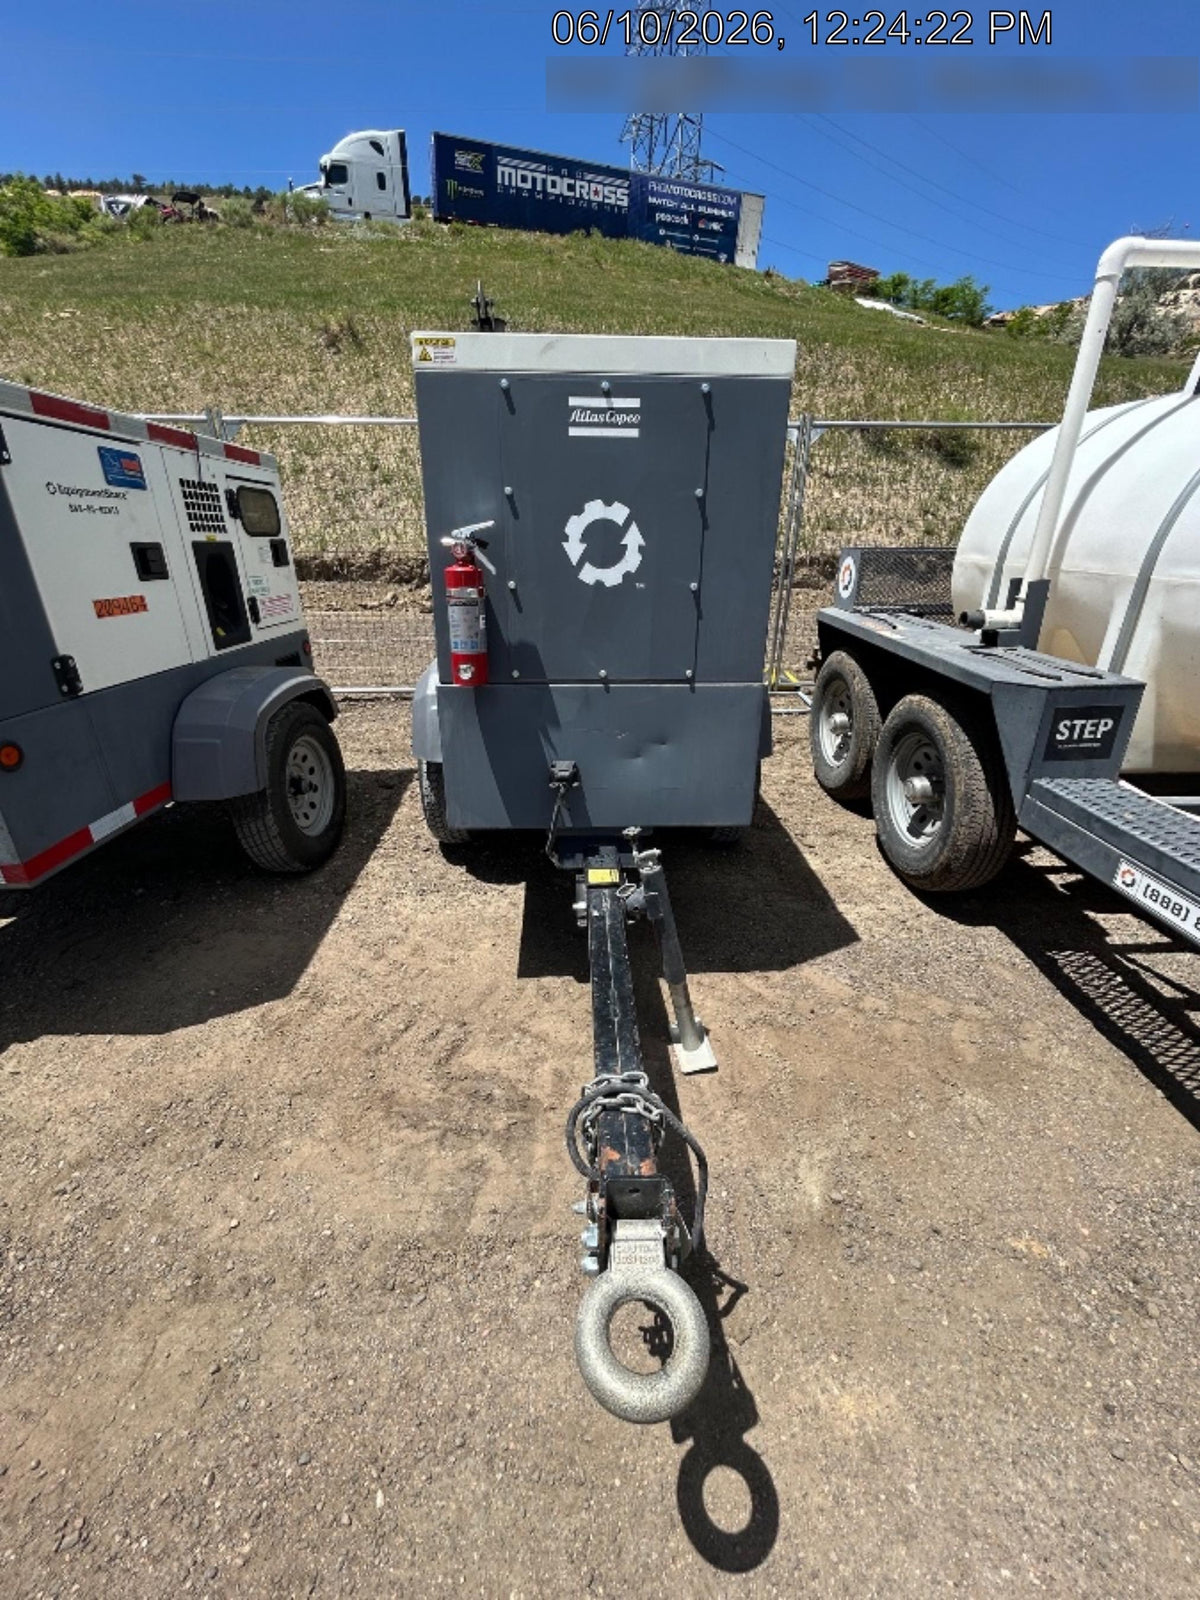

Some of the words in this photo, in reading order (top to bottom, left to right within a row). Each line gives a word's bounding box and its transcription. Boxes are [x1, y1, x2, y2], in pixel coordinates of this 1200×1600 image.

[497, 165, 630, 207] MOTOCROSS
[569, 408, 605, 423] Atlas
[605, 410, 641, 426] Copco
[1055, 718, 1115, 740] STEP
[1142, 883, 1191, 922] (888)
